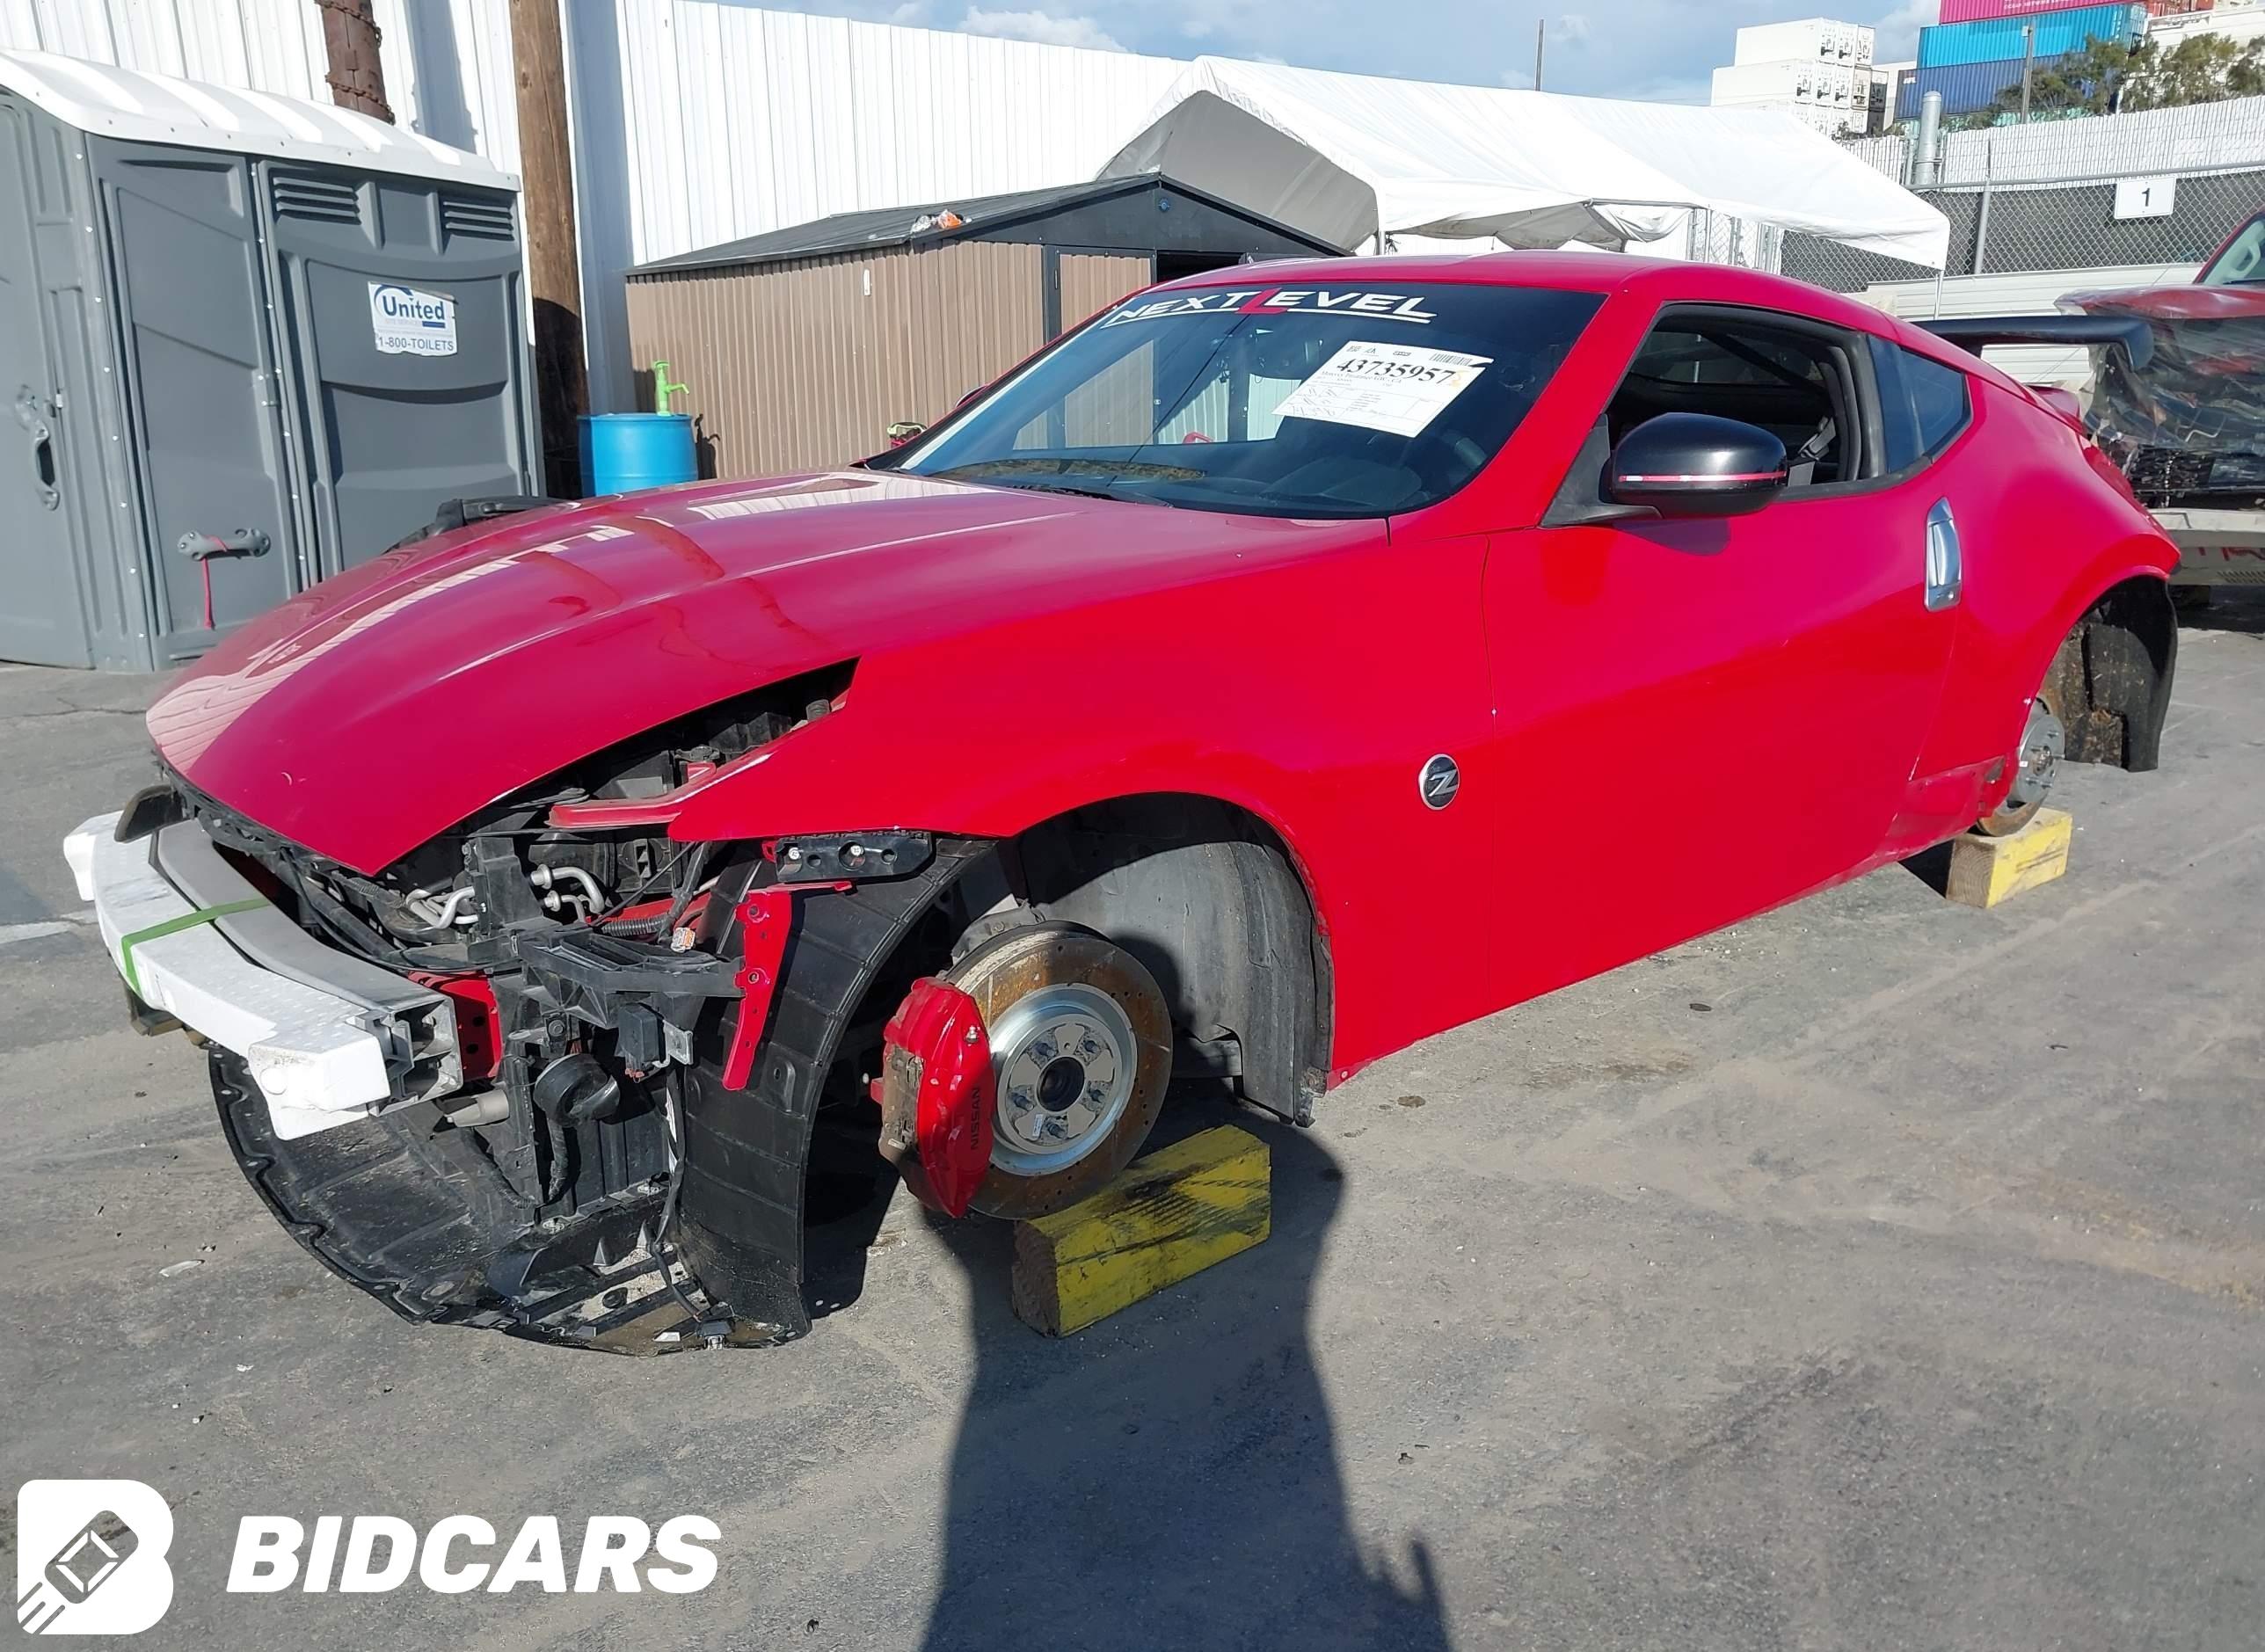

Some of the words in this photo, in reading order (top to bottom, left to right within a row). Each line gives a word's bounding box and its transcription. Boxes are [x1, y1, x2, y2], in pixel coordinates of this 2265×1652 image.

[2142, 187, 2151, 207] 1
[382, 295, 445, 320] United
[378, 337, 454, 351] 1-800-TOILETS
[1336, 358, 1456, 384] 43735957
[971, 1088, 980, 1151] NISSAN
